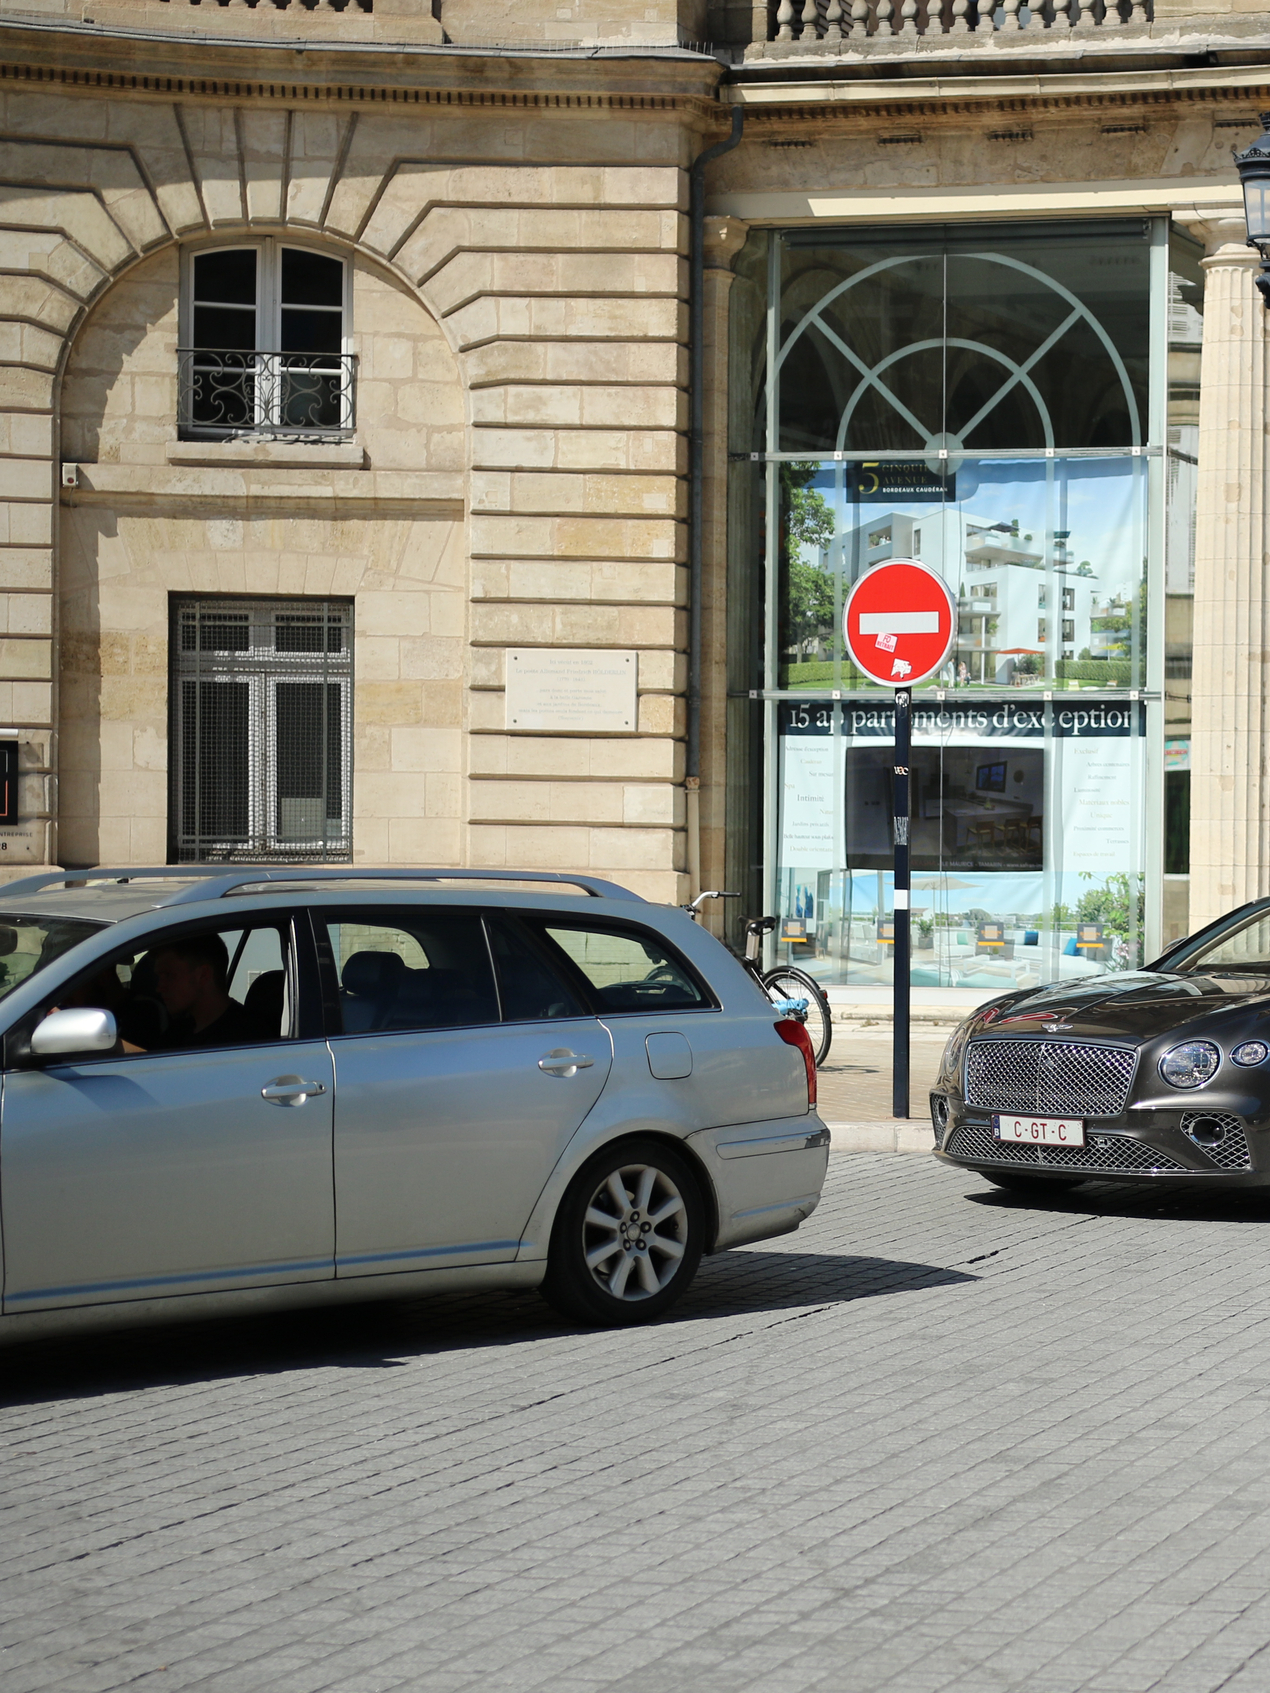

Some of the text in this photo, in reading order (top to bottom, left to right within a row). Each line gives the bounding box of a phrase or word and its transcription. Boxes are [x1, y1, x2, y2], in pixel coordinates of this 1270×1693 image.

[858, 462, 880, 494] 5
[882, 476, 928, 485] AVENUE
[789, 703, 811, 729] 15
[797, 794, 825, 802] Intimité
[1014, 1121, 1067, 1141] C-GT-C
